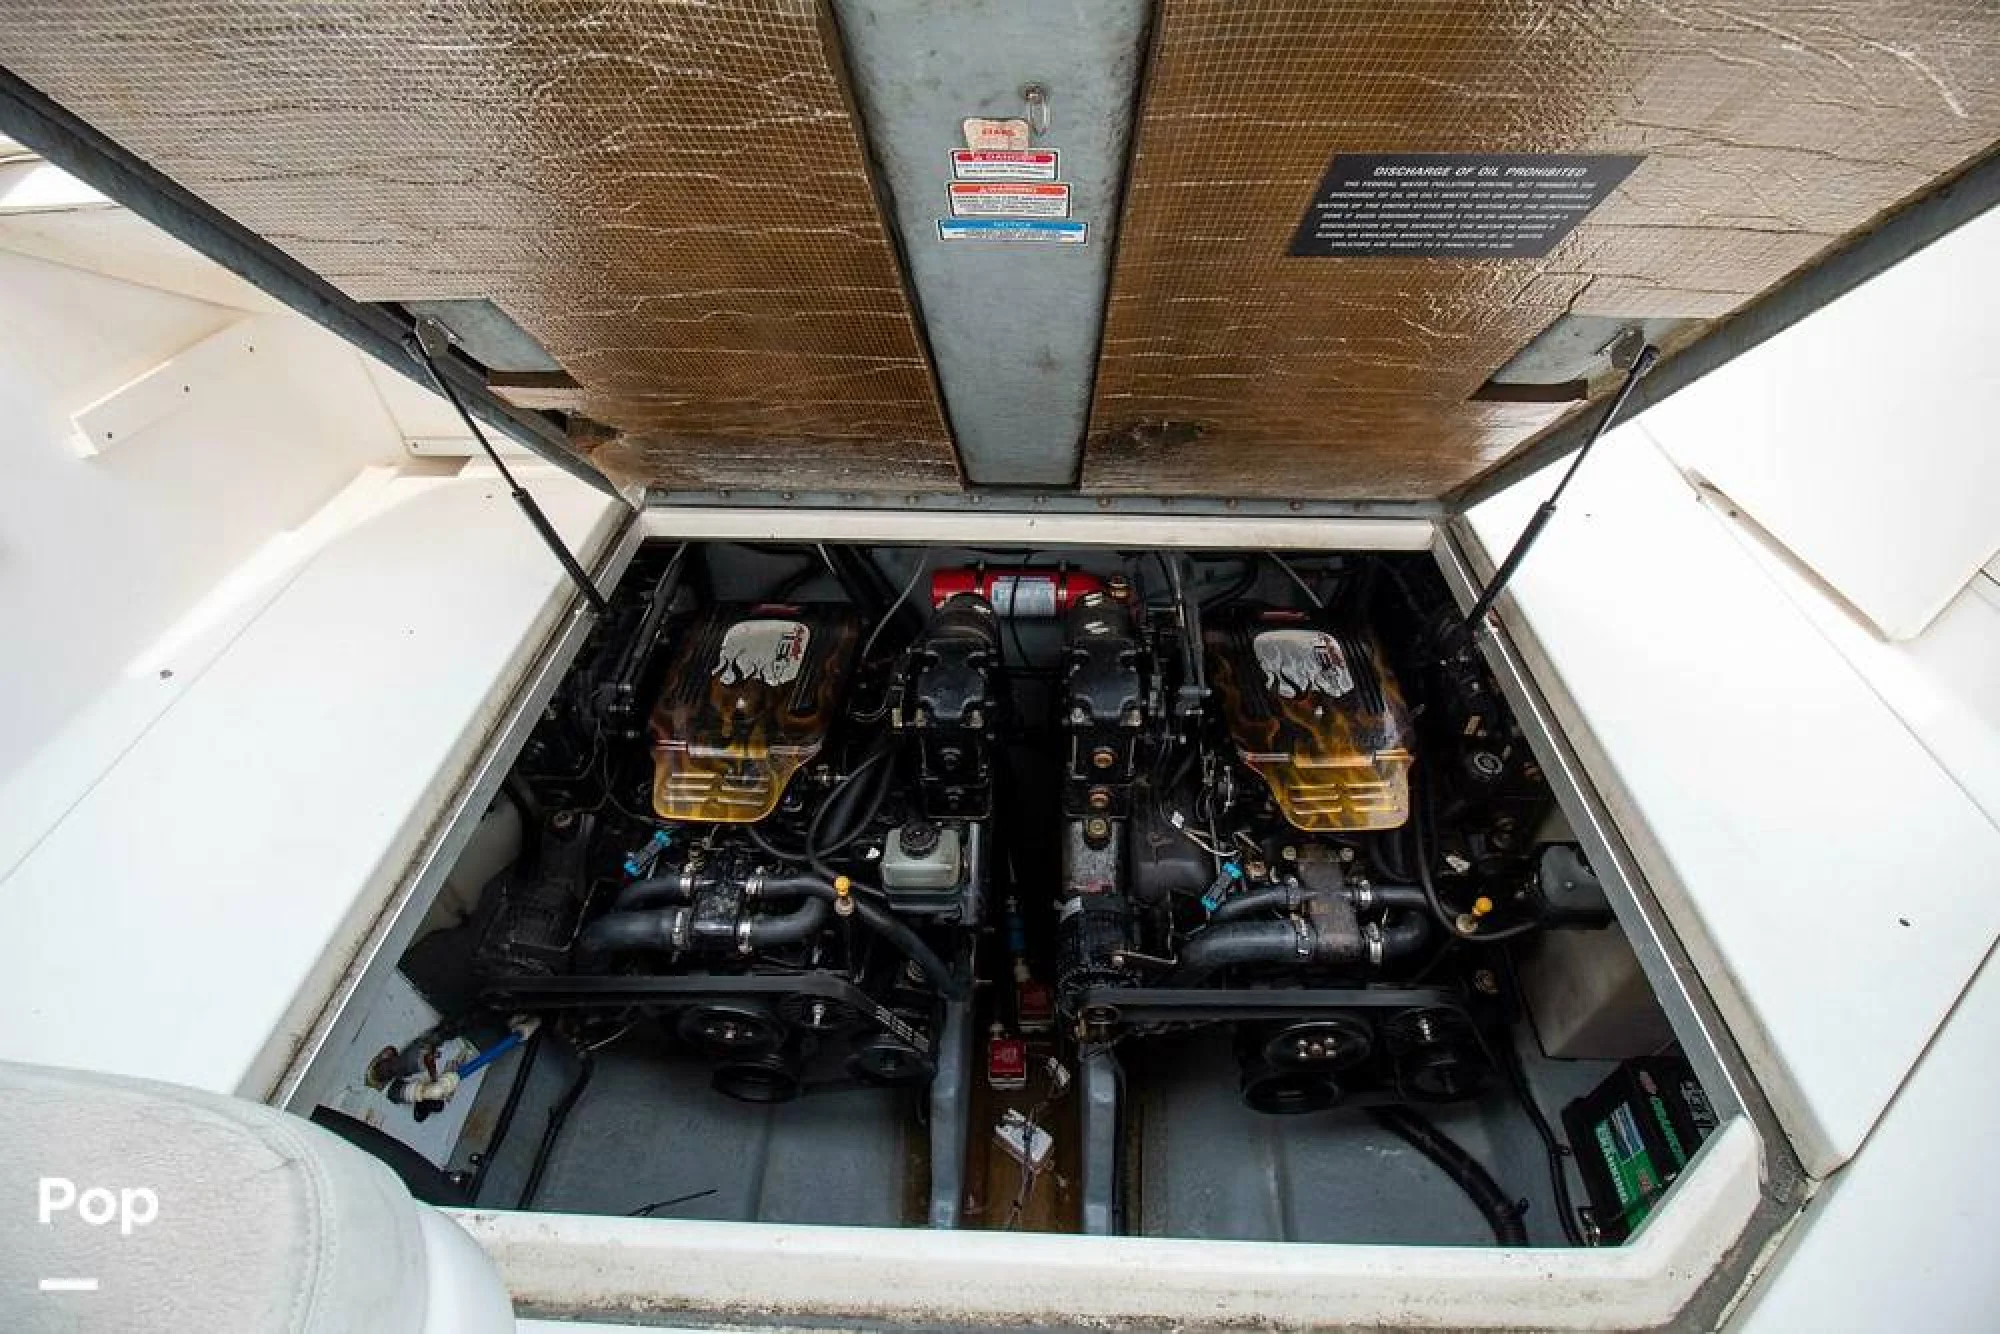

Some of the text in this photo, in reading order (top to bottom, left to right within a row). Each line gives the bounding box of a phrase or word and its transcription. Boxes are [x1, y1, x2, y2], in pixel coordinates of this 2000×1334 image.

[1373, 166, 1588, 177] DISCHARGE OF OIL PROHIBITED
